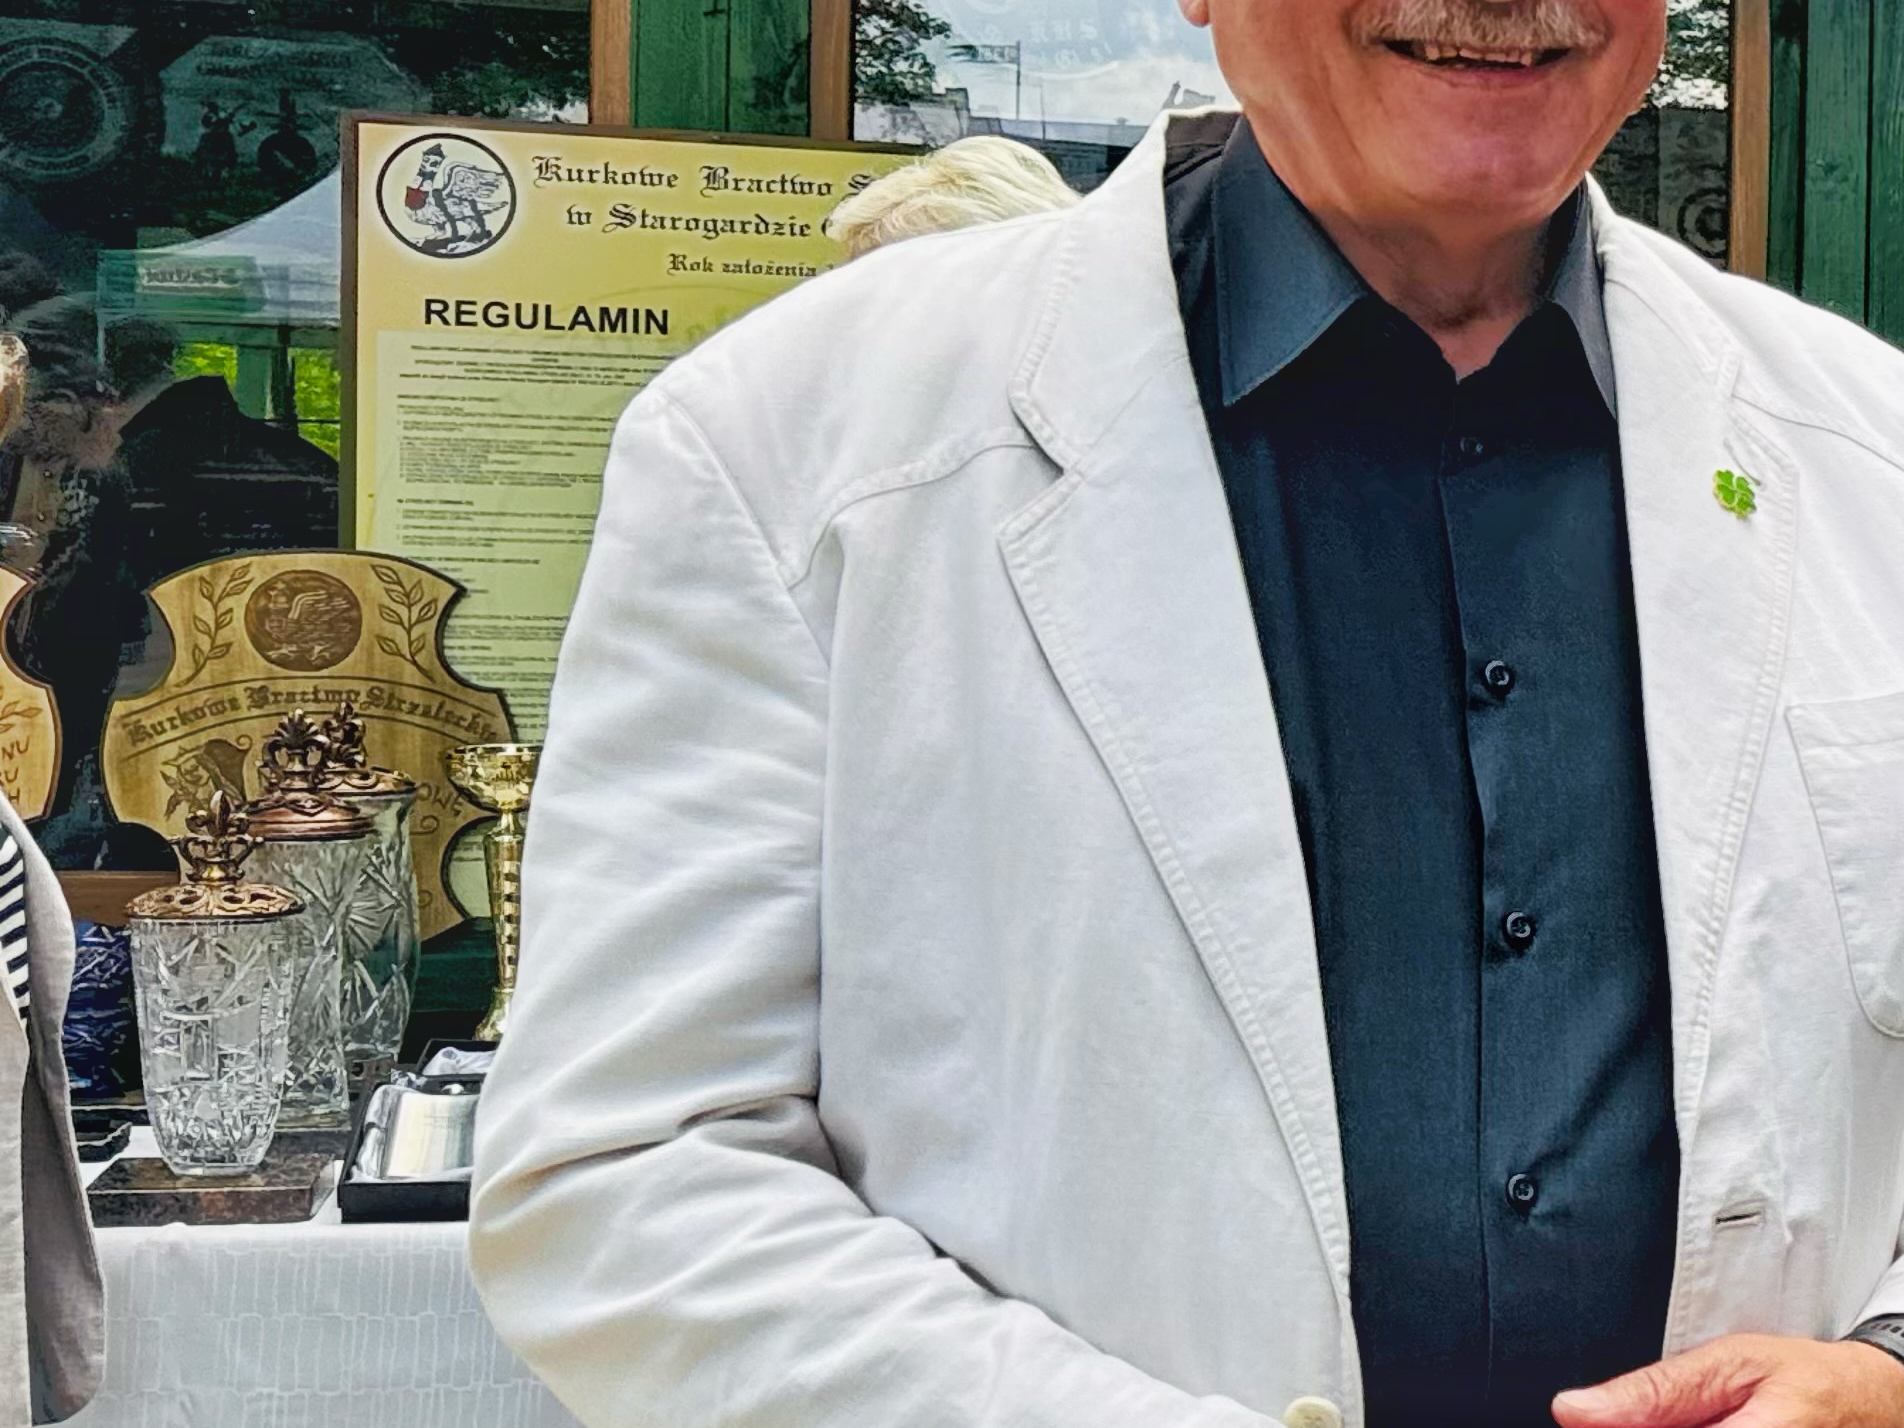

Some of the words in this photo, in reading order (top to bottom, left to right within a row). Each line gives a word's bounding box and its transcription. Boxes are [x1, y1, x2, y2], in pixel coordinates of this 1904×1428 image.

[532, 156, 679, 189] Kurkowe
[699, 165, 833, 198] Bractwo
[567, 204, 592, 225] w
[602, 203, 811, 239] Starogardzie
[667, 253, 714, 276] Rok
[423, 298, 669, 335] REGULAMIN
